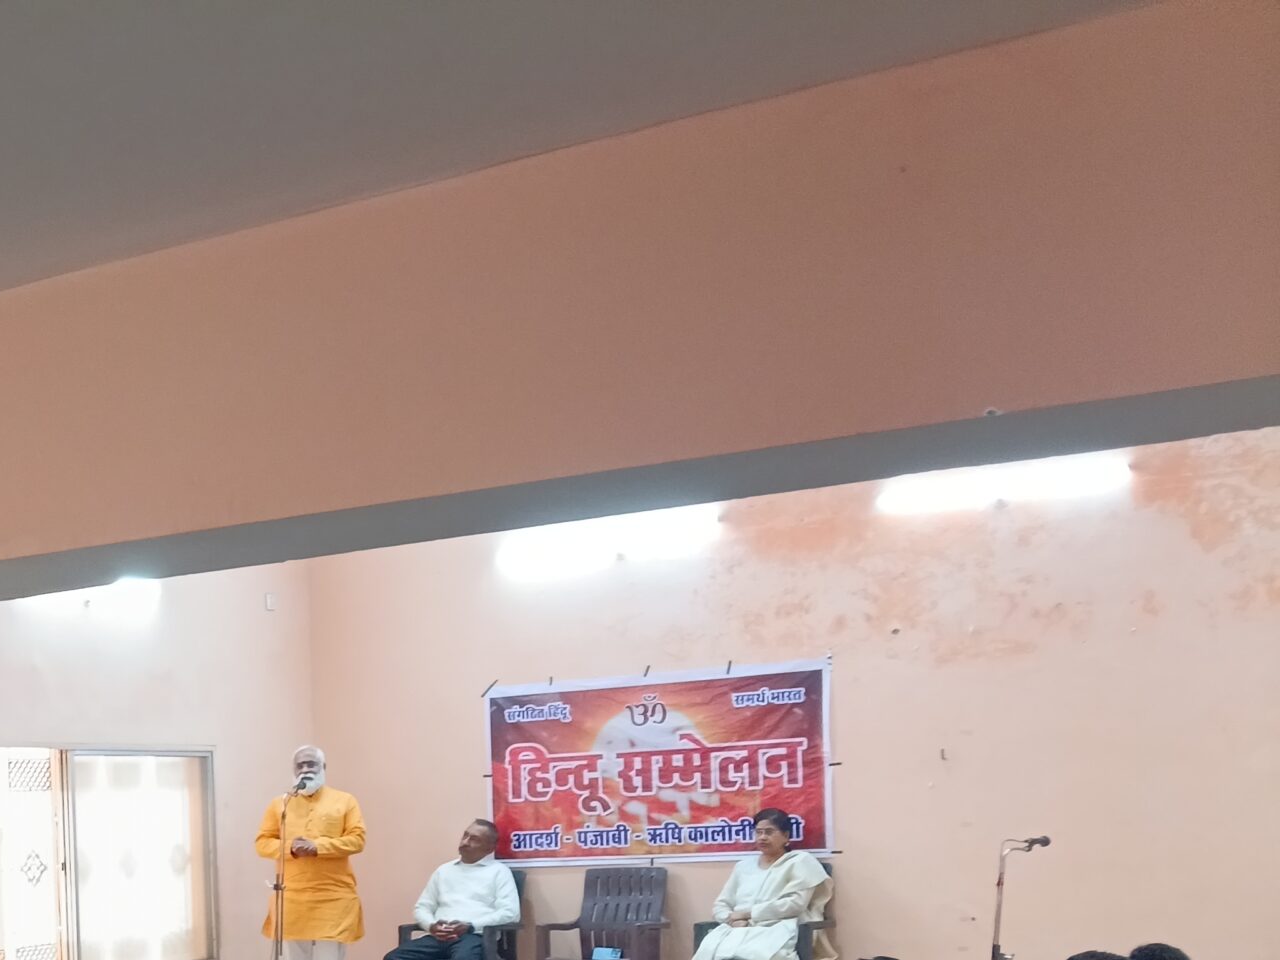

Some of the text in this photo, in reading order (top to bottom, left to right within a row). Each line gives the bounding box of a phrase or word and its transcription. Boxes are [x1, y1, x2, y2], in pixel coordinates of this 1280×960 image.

[733, 688, 805, 706] समर्थ भारत
[506, 733, 808, 816] हिन्दू सम्मेलन
[512, 825, 561, 850] आदर्श
[577, 823, 630, 847] पंजाबी
[646, 821, 684, 845] ऋषि
[688, 818, 755, 842] कालोनी
